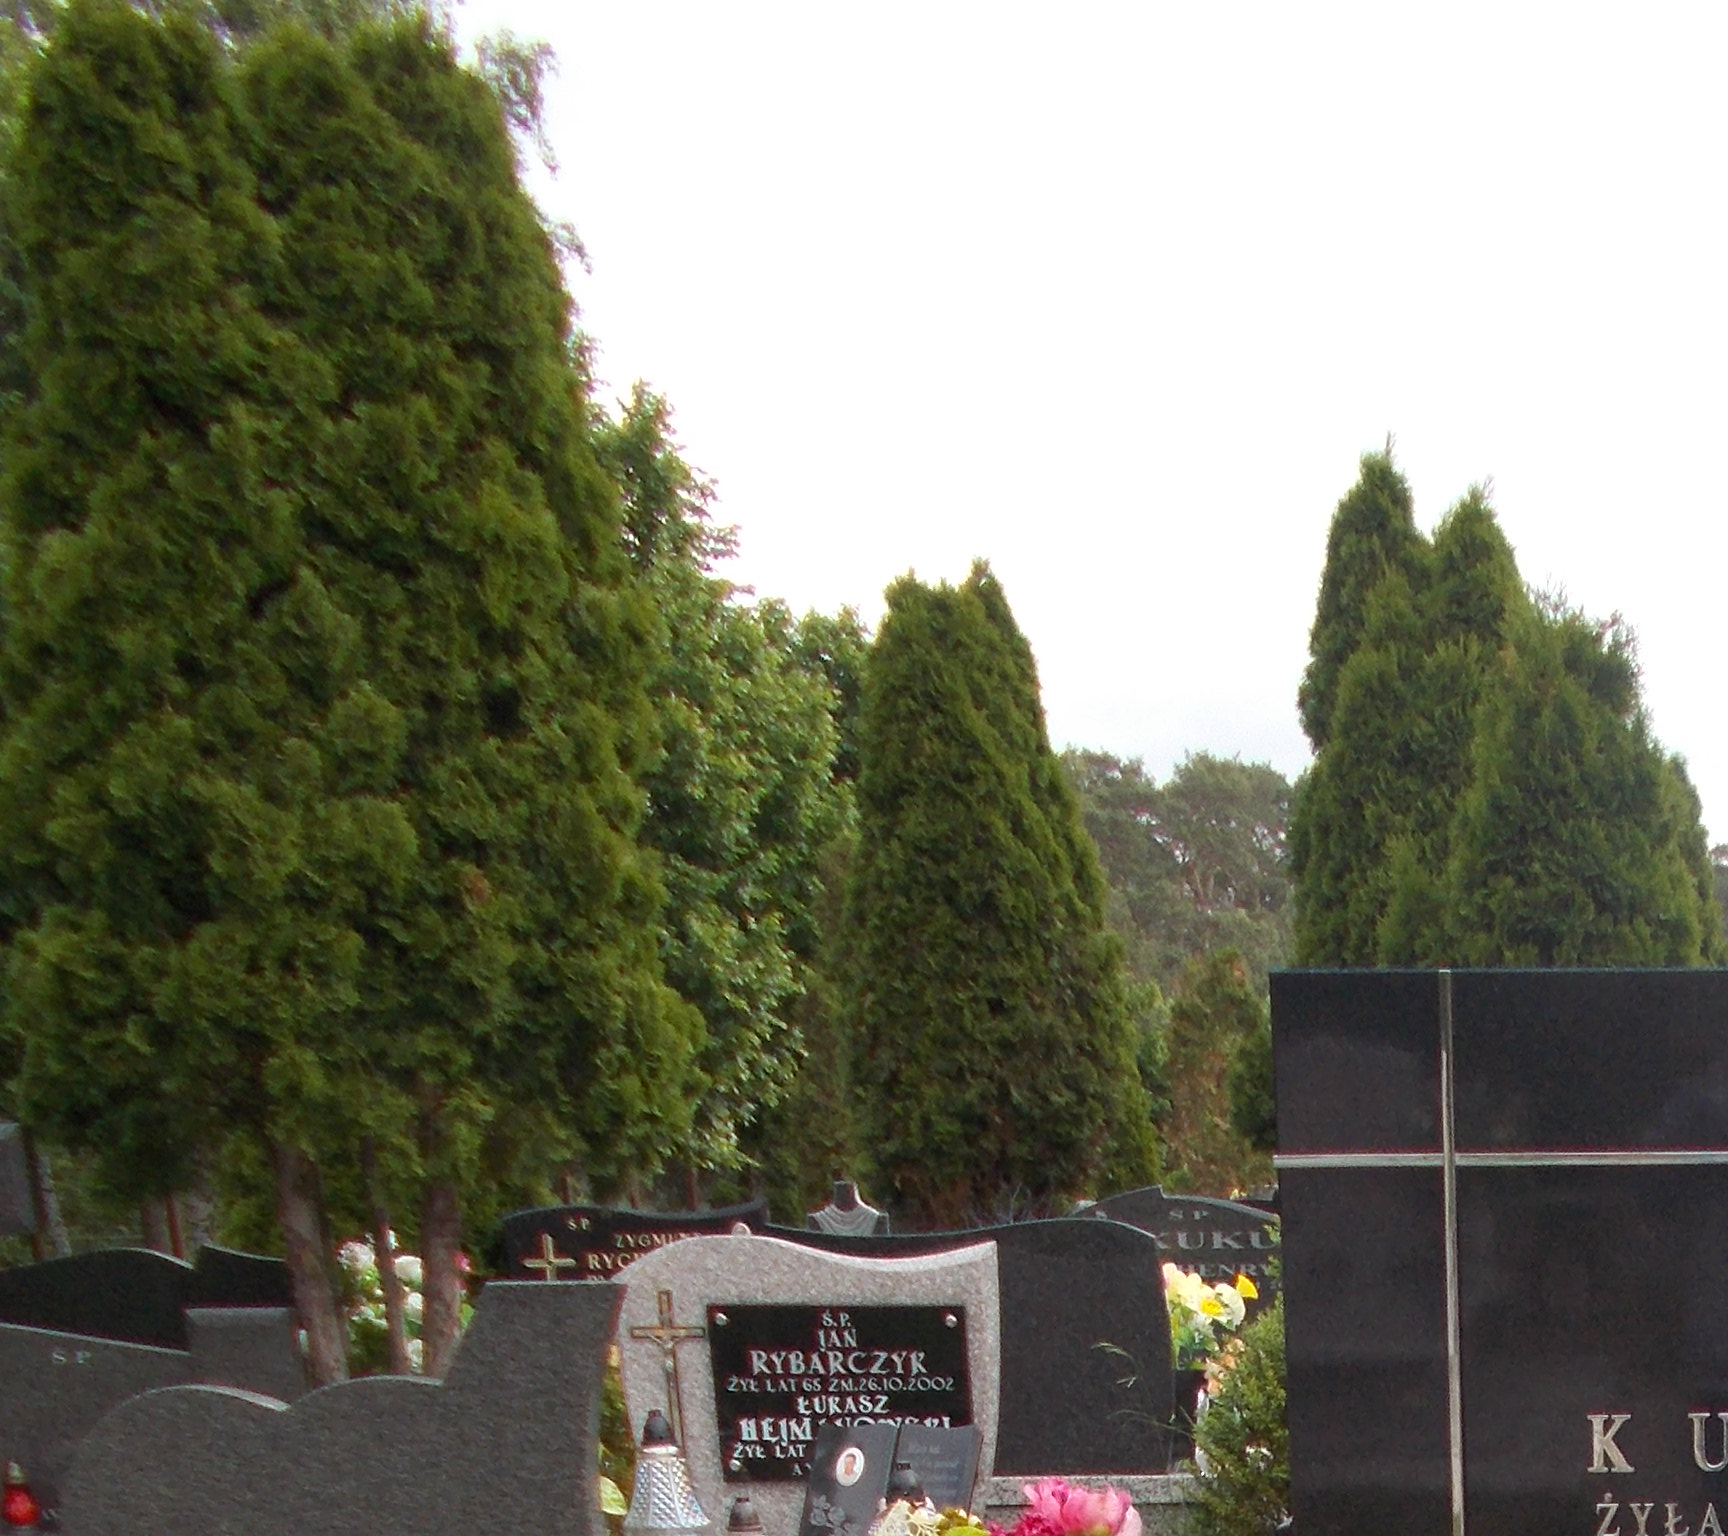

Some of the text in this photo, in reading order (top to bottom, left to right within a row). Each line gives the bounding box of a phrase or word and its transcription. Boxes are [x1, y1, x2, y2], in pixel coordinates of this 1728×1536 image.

[749, 1349, 928, 1377] RYBARCZYK
[766, 1377, 797, 1393] LAT
[797, 1394, 891, 1415] ŁUKASZ
[776, 1444, 807, 1459] LAT
